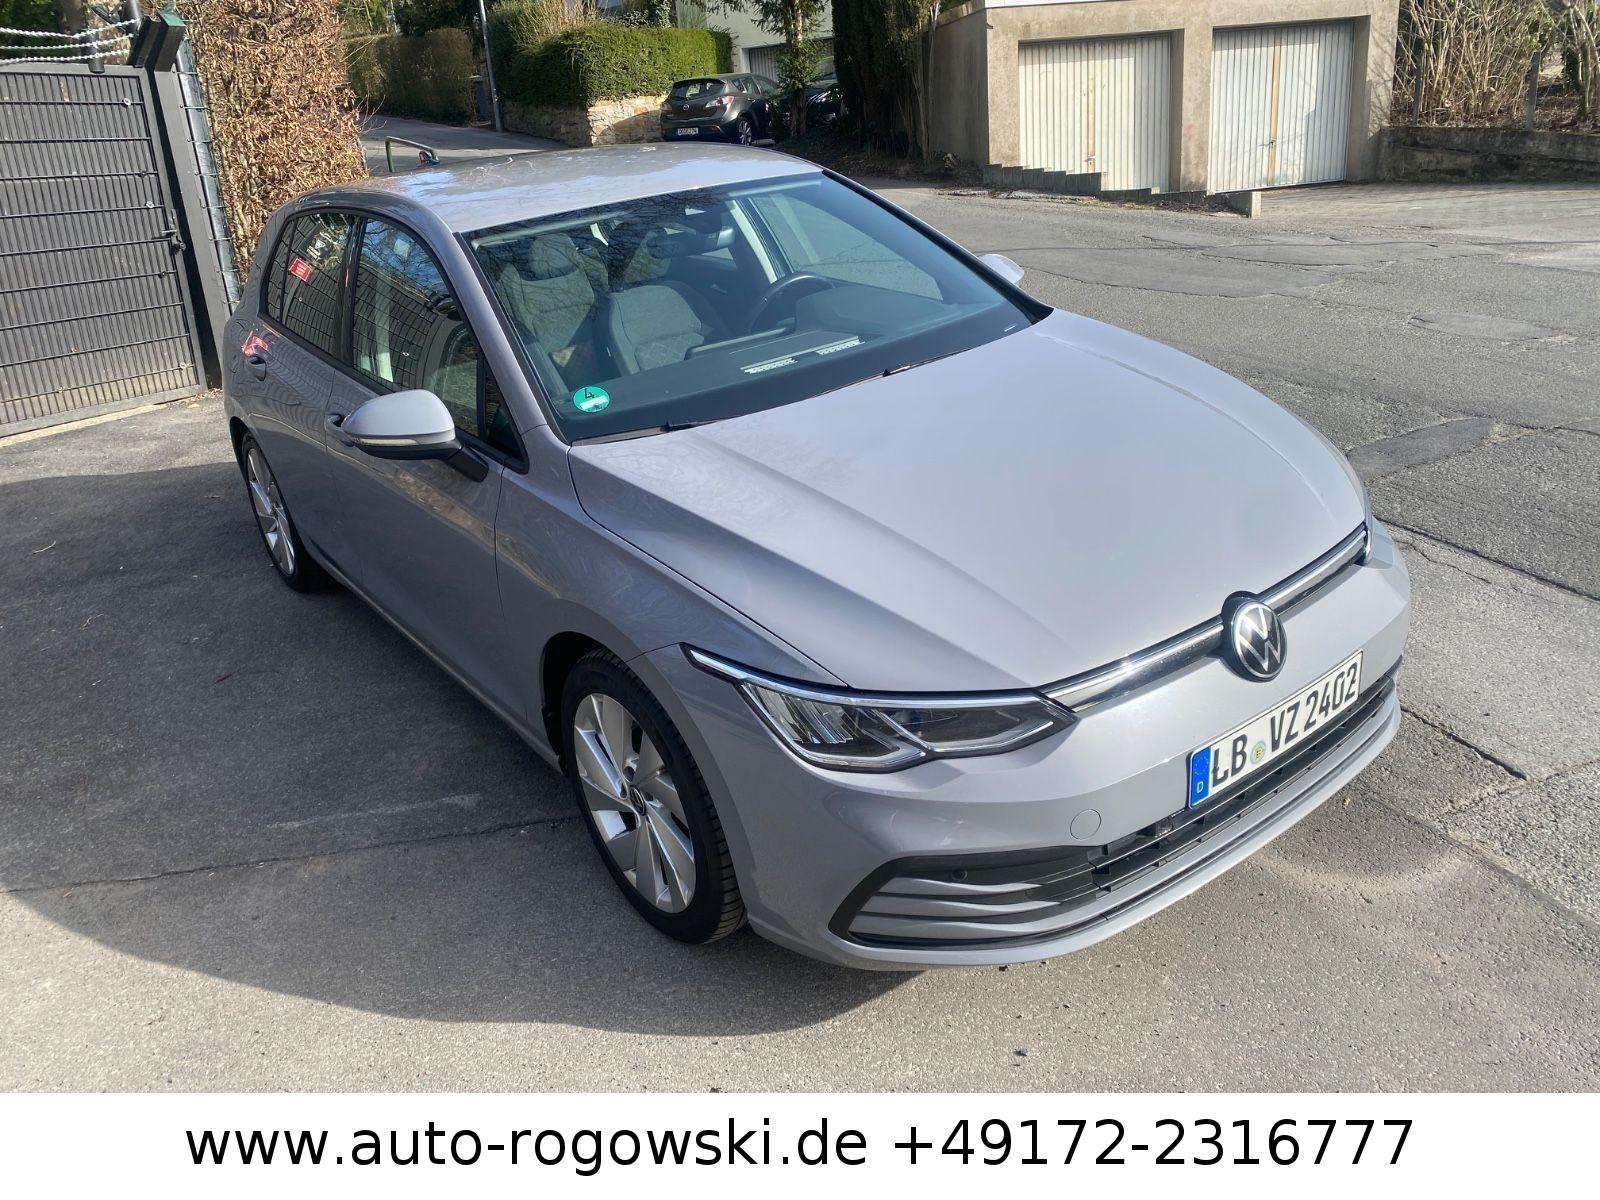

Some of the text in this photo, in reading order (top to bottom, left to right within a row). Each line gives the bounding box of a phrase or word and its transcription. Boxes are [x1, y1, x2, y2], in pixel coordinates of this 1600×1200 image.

[584, 387, 595, 399] 4
[1211, 662, 1358, 788] LB VZ 2402
[1196, 781, 1204, 794] D
